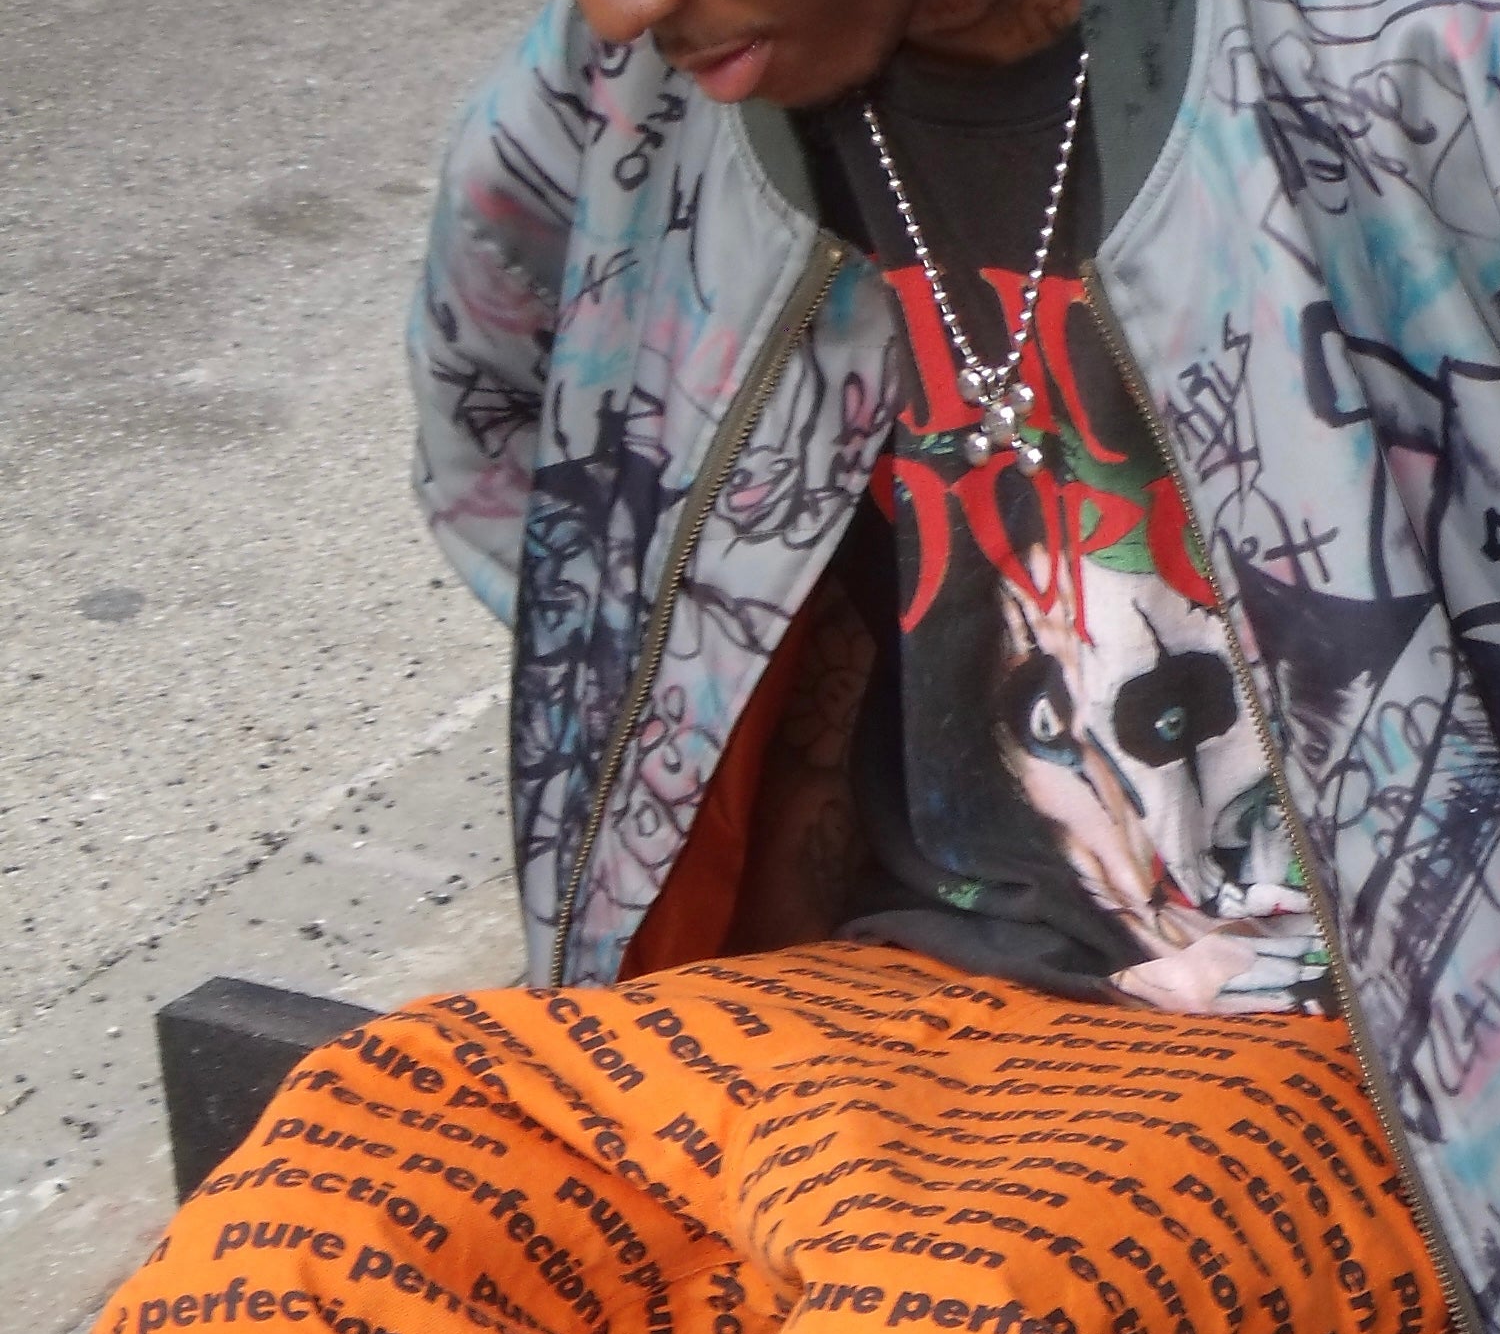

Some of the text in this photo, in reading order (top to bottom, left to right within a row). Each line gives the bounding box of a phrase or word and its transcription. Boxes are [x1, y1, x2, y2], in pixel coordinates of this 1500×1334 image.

[949, 1025, 1235, 1061] perfection
[1051, 1014, 1178, 1033] pure
[286, 1069, 508, 1157] rfection
[894, 1064, 1182, 1103] perfection
[836, 1098, 1128, 1153] perfection
[880, 1140, 1009, 1170] pure
[995, 1057, 1377, 1219] pure perfection
[1281, 1073, 1388, 1167] pure
[939, 1107, 1314, 1278] pure perfection
[1228, 1118, 1331, 1218] pure
[213, 1220, 347, 1261] pure
[262, 1117, 397, 1159] pure
[400, 1153, 604, 1325] perfection
[555, 1176, 648, 1264] pure
[821, 1193, 946, 1226] pure
